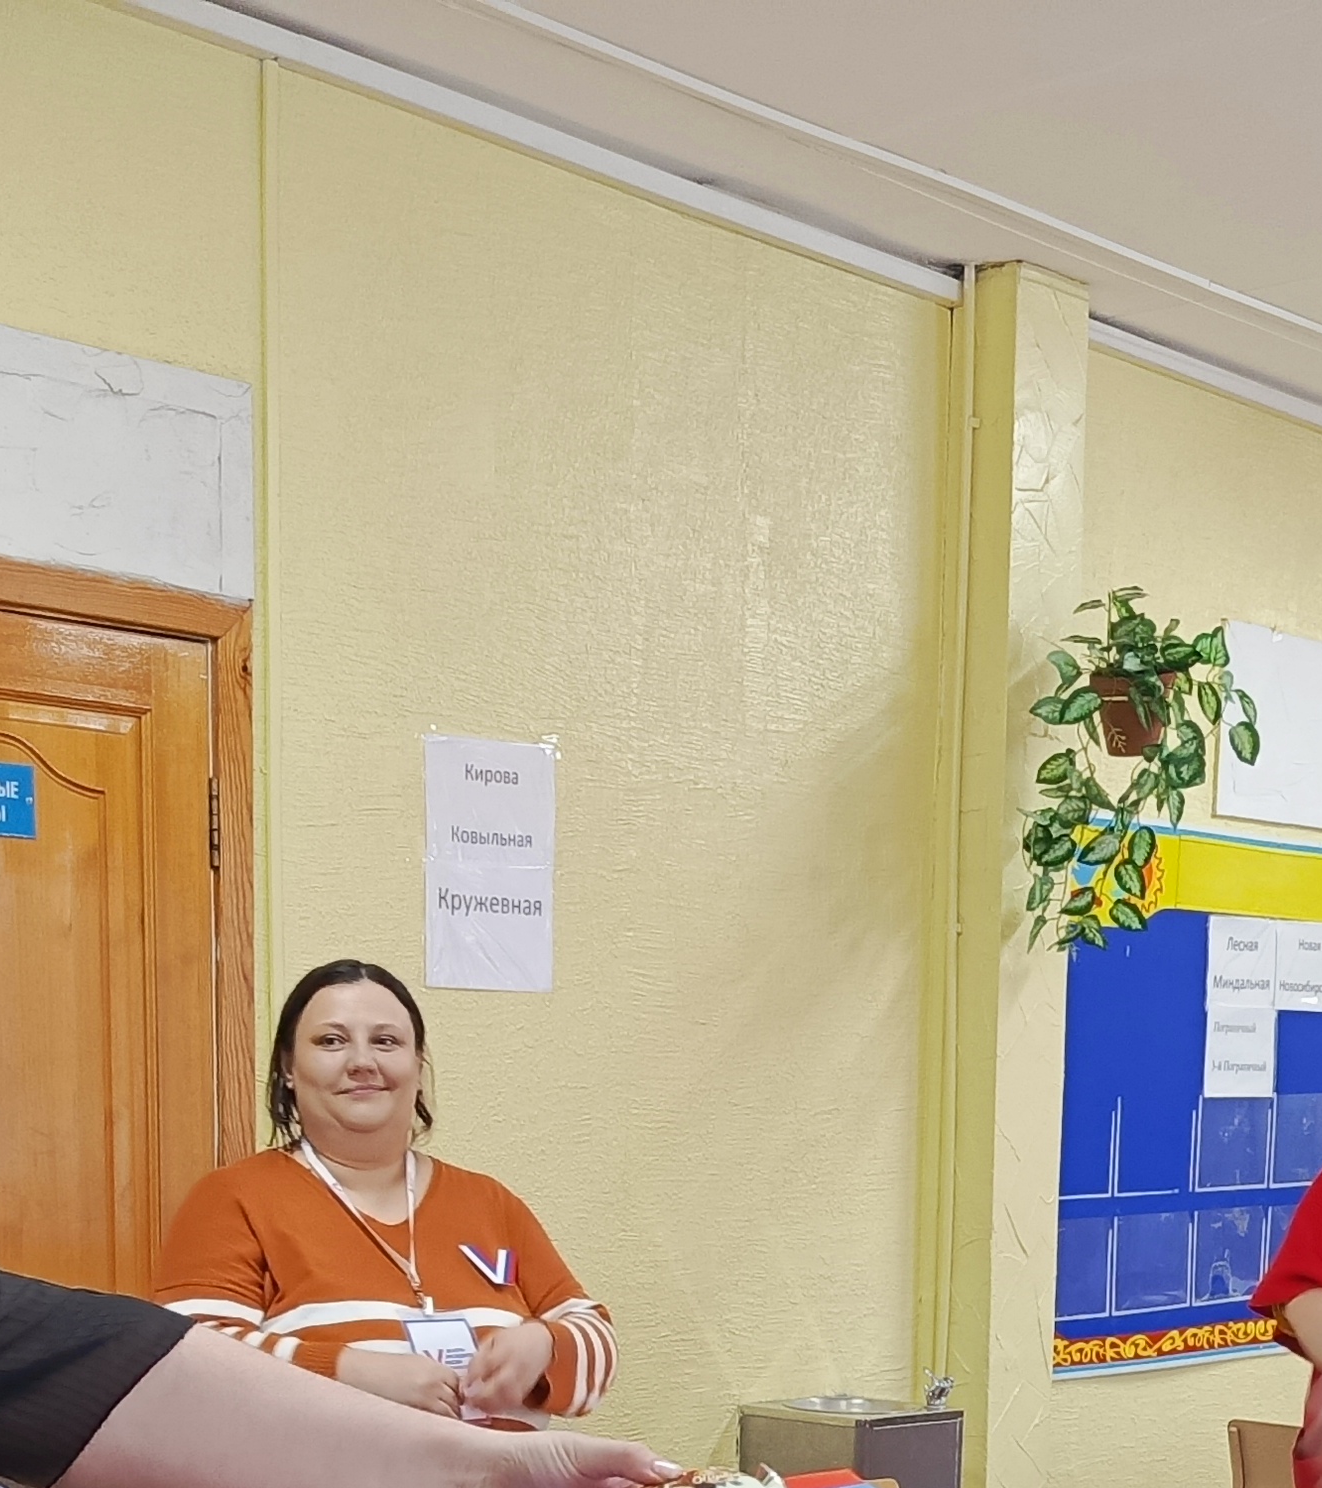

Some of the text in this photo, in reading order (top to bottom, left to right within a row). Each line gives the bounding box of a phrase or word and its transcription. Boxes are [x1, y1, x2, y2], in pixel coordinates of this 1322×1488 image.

[465, 763, 519, 786] Кирова
[450, 825, 533, 849] Ковыльная
[438, 886, 543, 917] Кружевная
[1226, 936, 1259, 952] Лесная
[1298, 939, 1322, 952] Новая
[1213, 975, 1271, 993] Миндальная
